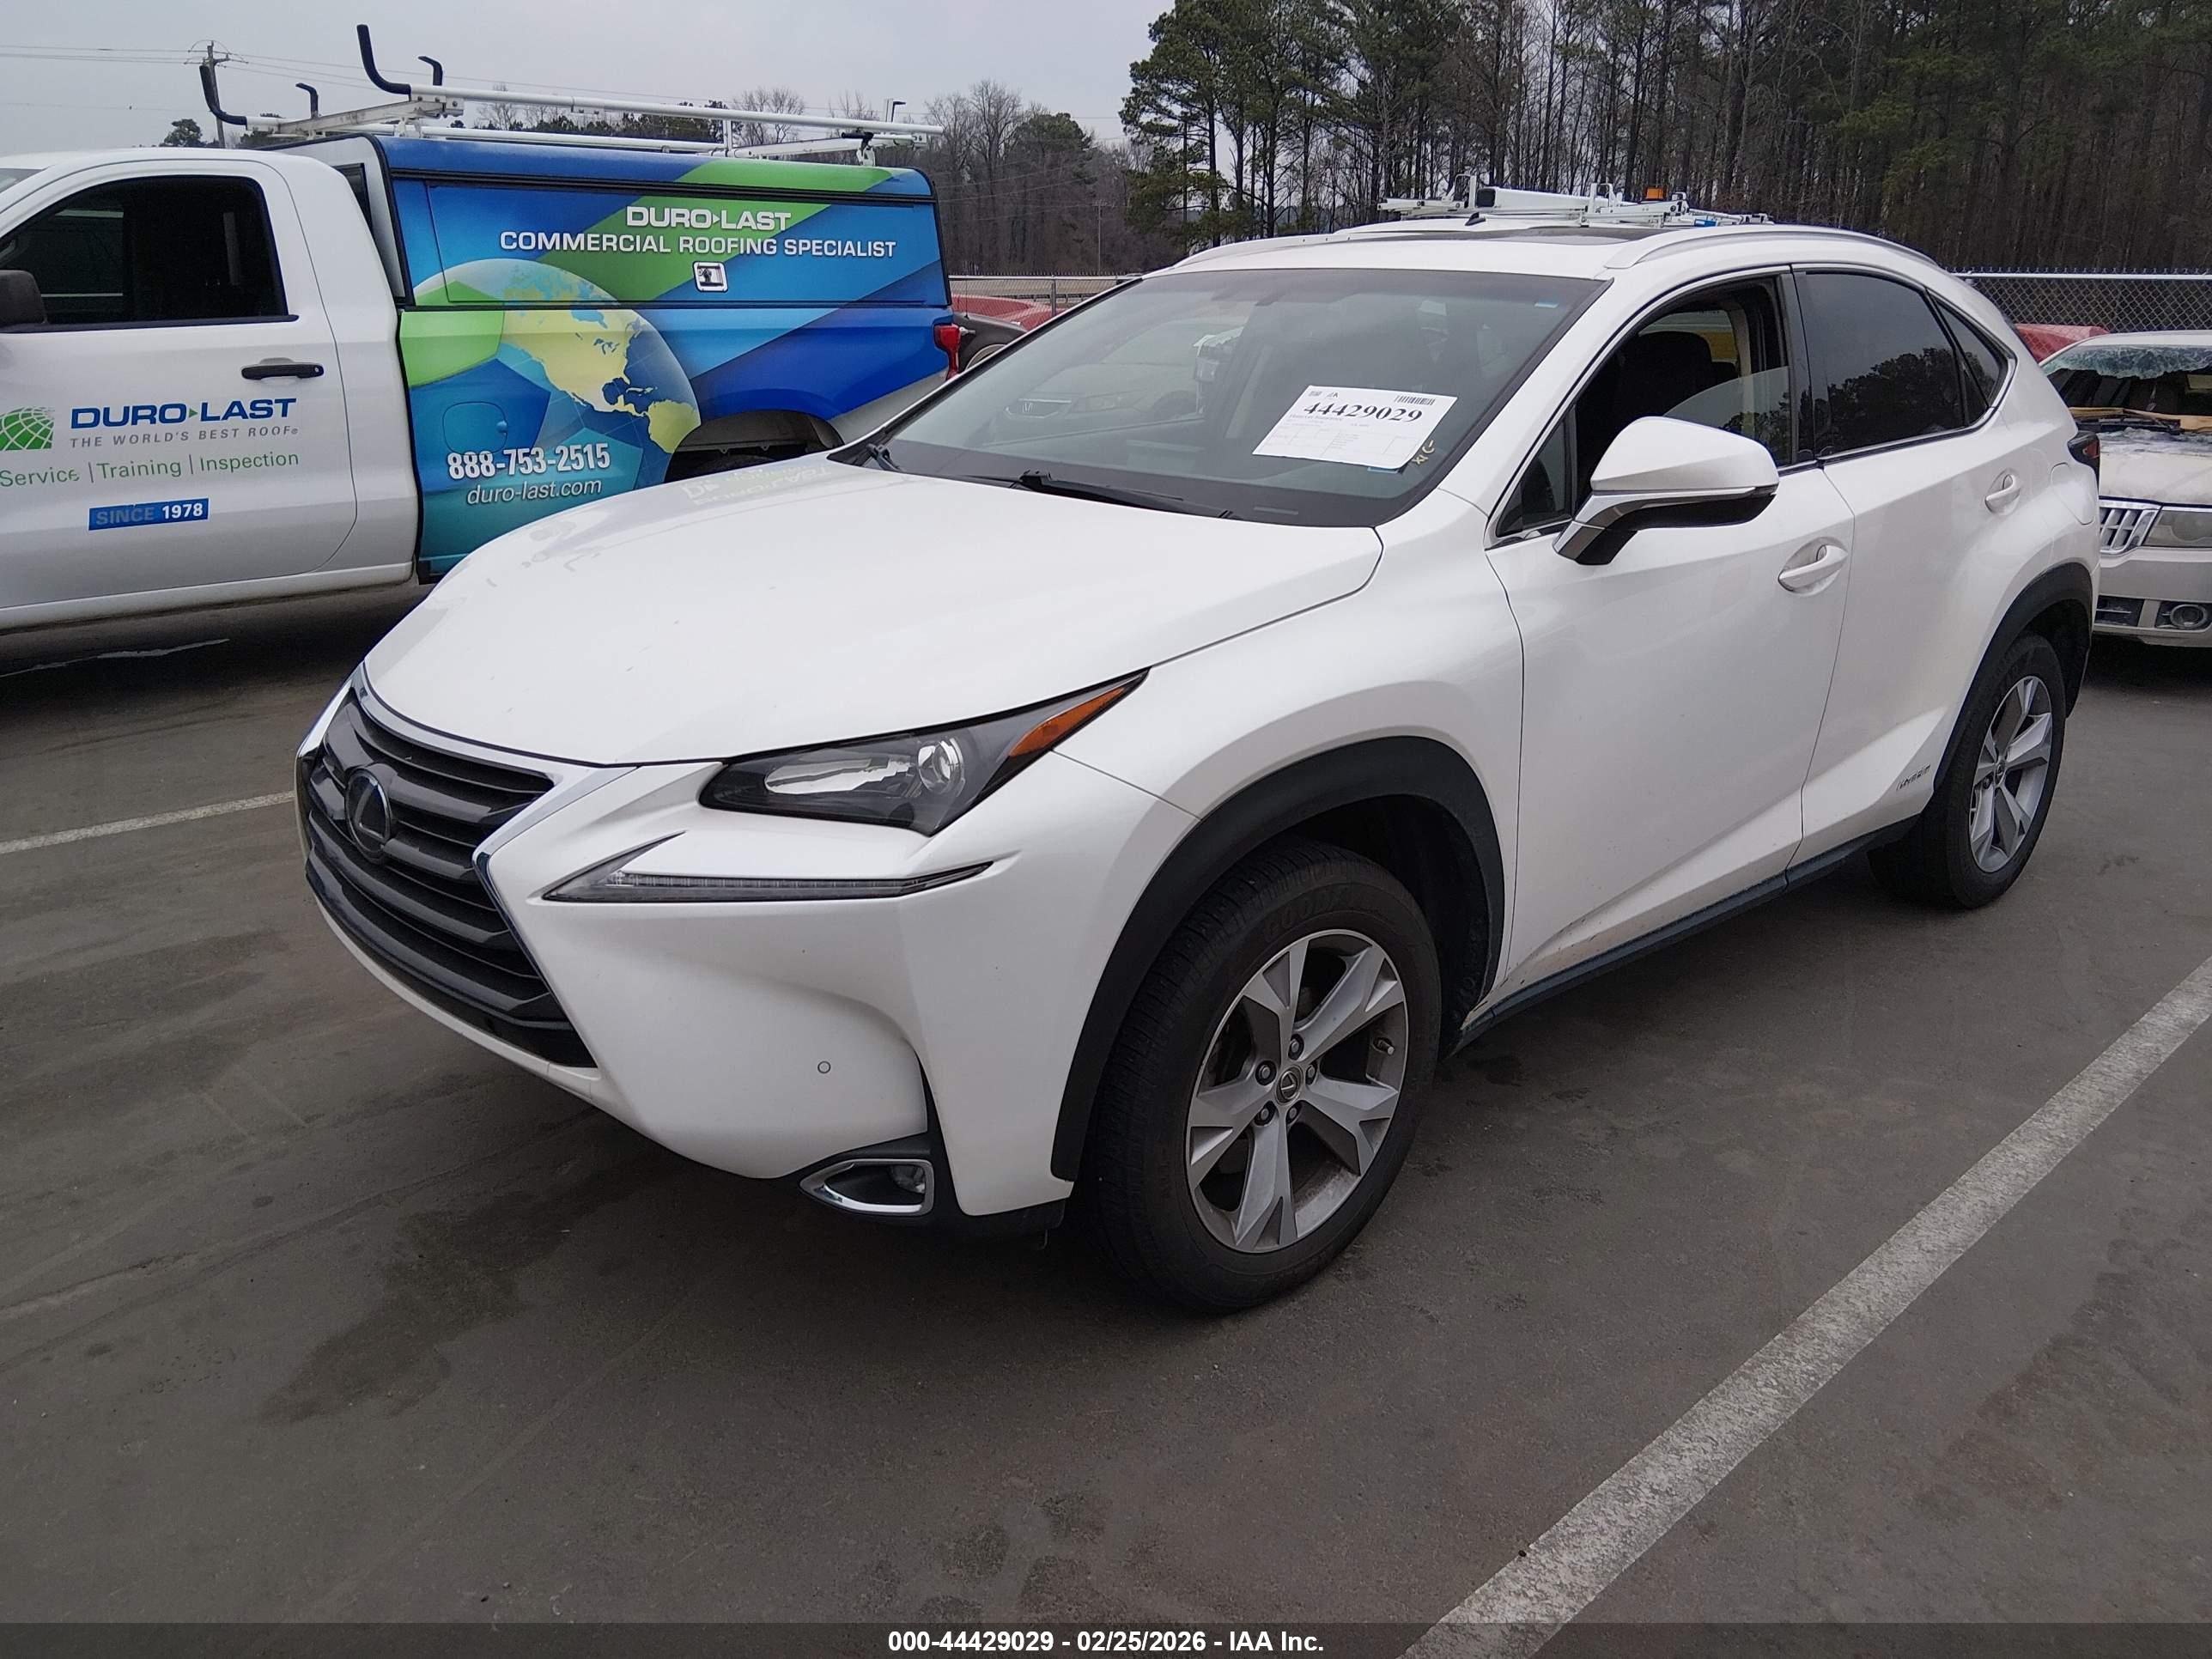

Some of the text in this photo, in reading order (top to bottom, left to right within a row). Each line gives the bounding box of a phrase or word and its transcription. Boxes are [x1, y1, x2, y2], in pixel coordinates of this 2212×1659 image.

[500, 231, 896, 257] COMMERCIAL ROOFING SPECIALIST
[1304, 402, 1423, 423] 44429029
[70, 436, 103, 448] THE
[112, 431, 189, 446] WORLD'S
[198, 428, 240, 441] BEST
[0, 466, 80, 488] Service
[96, 459, 182, 479] Training
[199, 451, 300, 473] Inspection
[447, 442, 611, 480] 888-753-2515
[466, 479, 603, 505] duro-last.com
[94, 501, 204, 526] SINCE 1978
